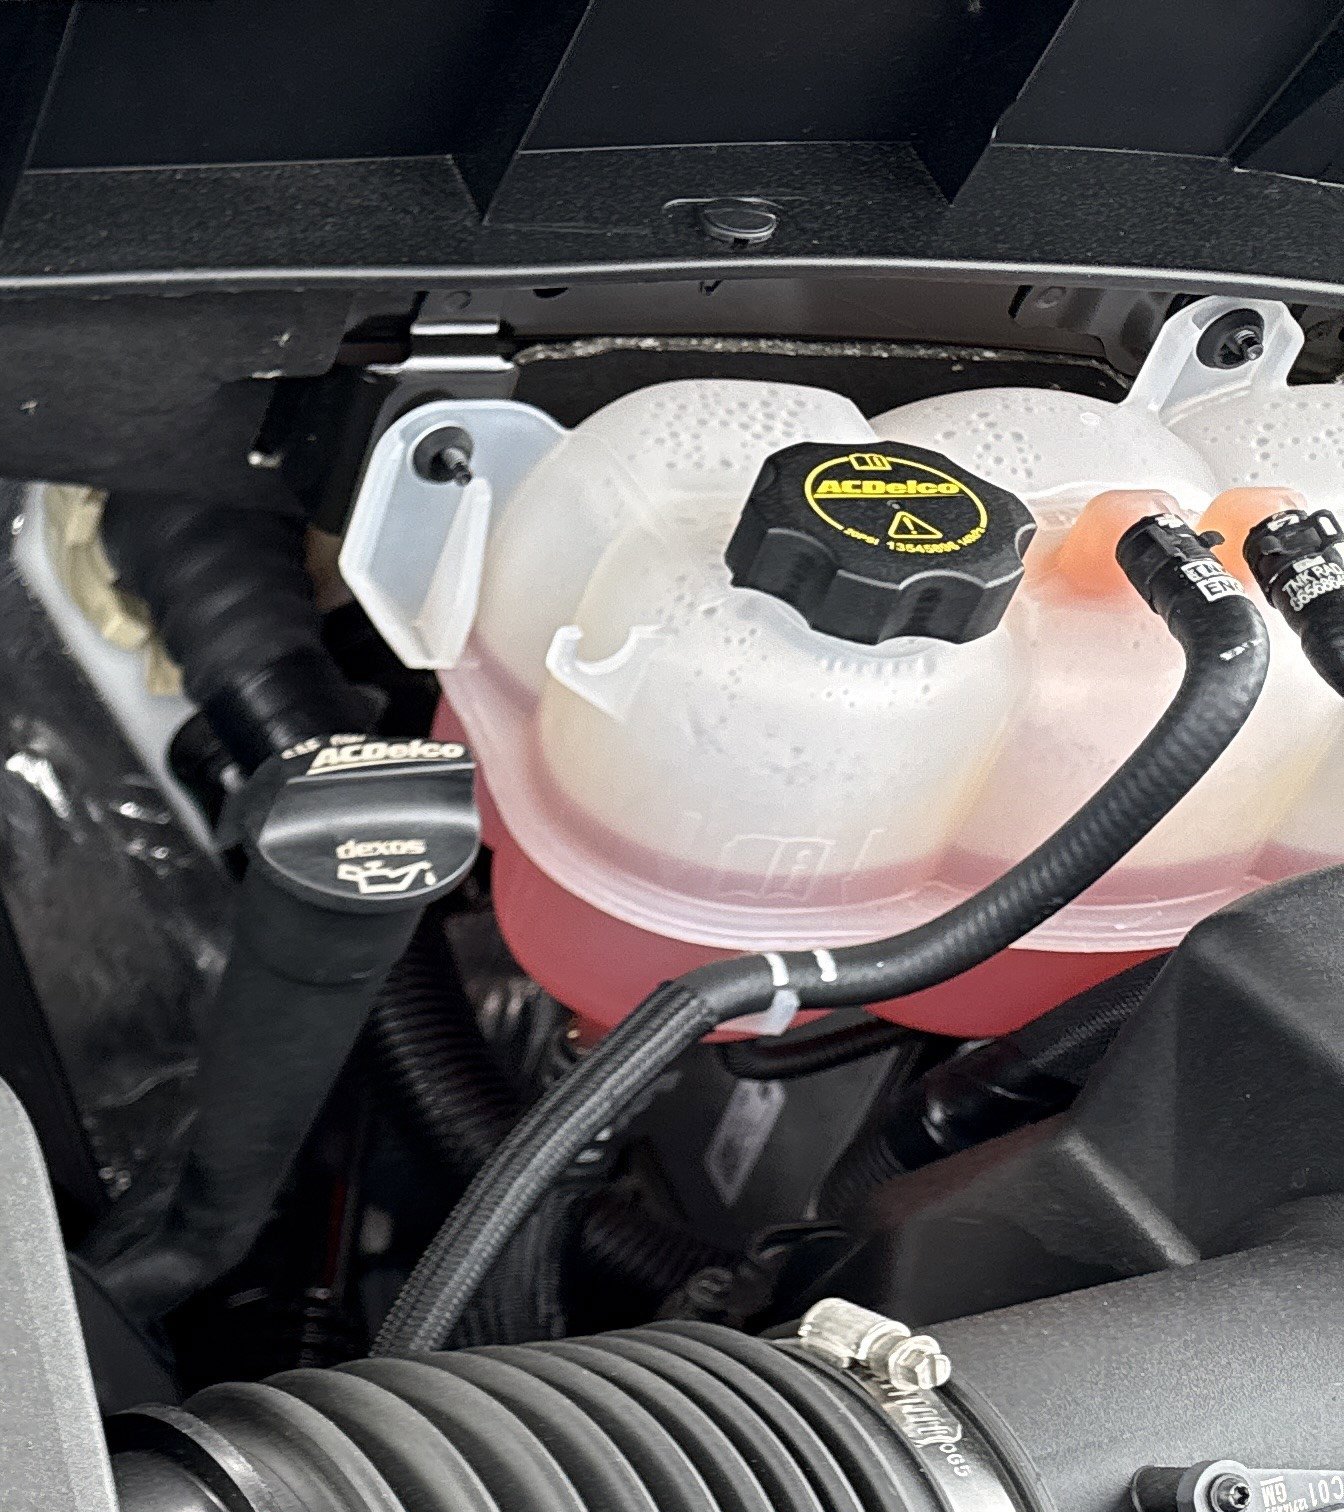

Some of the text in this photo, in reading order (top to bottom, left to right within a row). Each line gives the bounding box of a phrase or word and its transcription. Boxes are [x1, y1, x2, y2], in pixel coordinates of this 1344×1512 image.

[816, 480, 960, 494] ACDelco
[311, 740, 464, 768] ACDelco
[336, 839, 426, 859] dexos
[1261, 1481, 1288, 1508] GM
